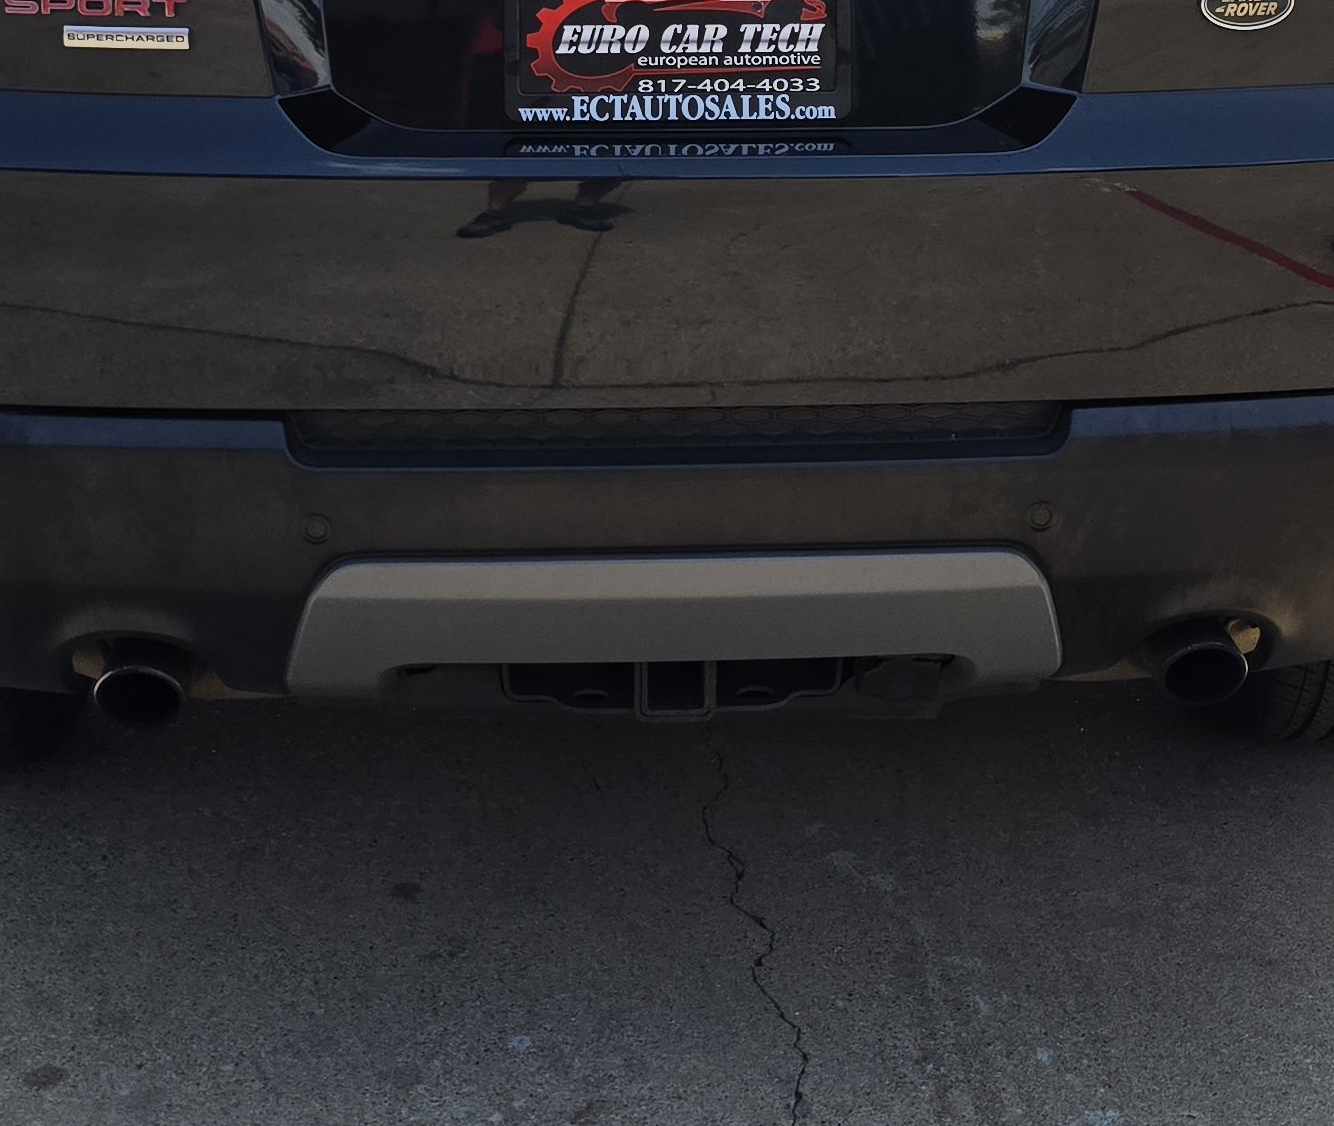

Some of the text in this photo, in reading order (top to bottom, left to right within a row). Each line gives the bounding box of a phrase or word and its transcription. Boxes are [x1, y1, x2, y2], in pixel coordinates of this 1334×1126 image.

[1224, 2, 1278, 17] ROVER
[67, 32, 185, 43] SUPERCHARGED
[556, 23, 826, 54] EURO CAR TECH
[637, 53, 821, 68] european automotive
[638, 78, 821, 92] 817-404-4033
[518, 93, 837, 121] www.ECTAUTOSALES.com
